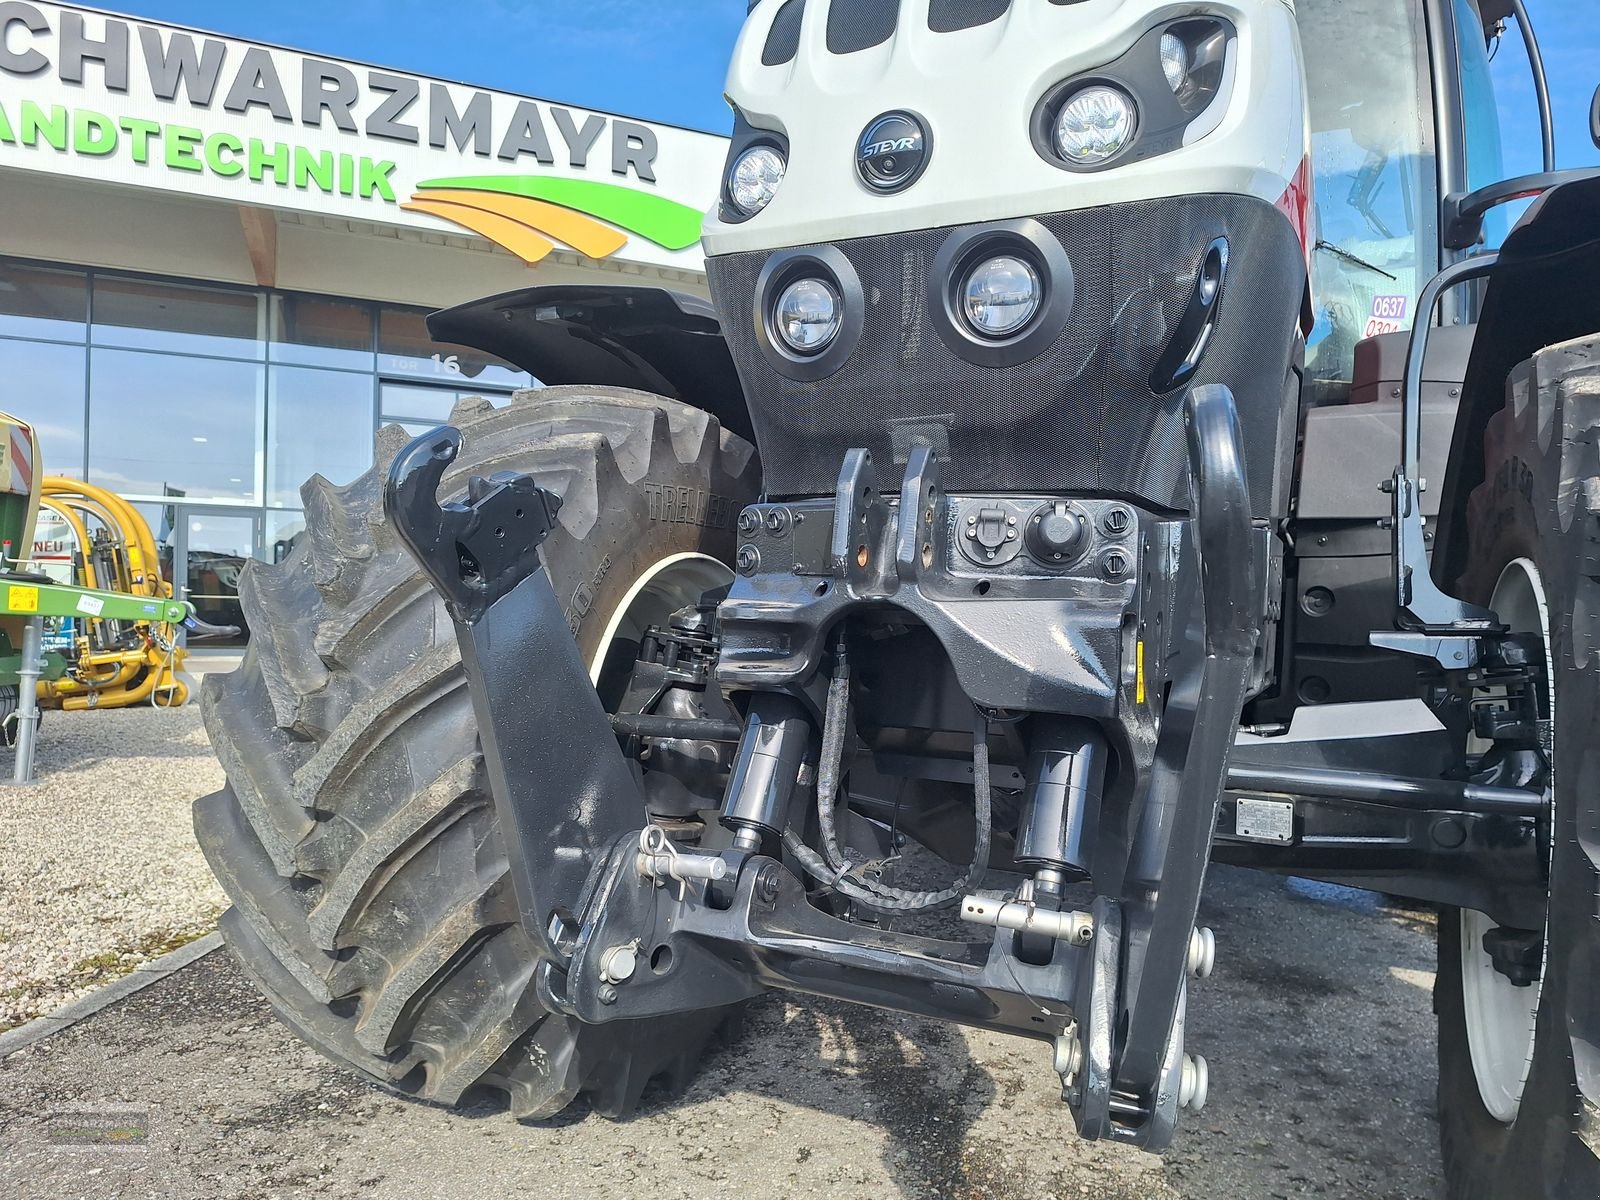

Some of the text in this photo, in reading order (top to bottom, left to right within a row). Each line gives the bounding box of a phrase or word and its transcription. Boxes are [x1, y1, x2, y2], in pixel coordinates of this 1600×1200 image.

[0, 1, 657, 183] CHWARZMAYR
[863, 137, 915, 159] STEYR
[1373, 297, 1405, 317] 0637
[391, 353, 461, 374] TOR 16
[34, 541, 63, 552] NEU
